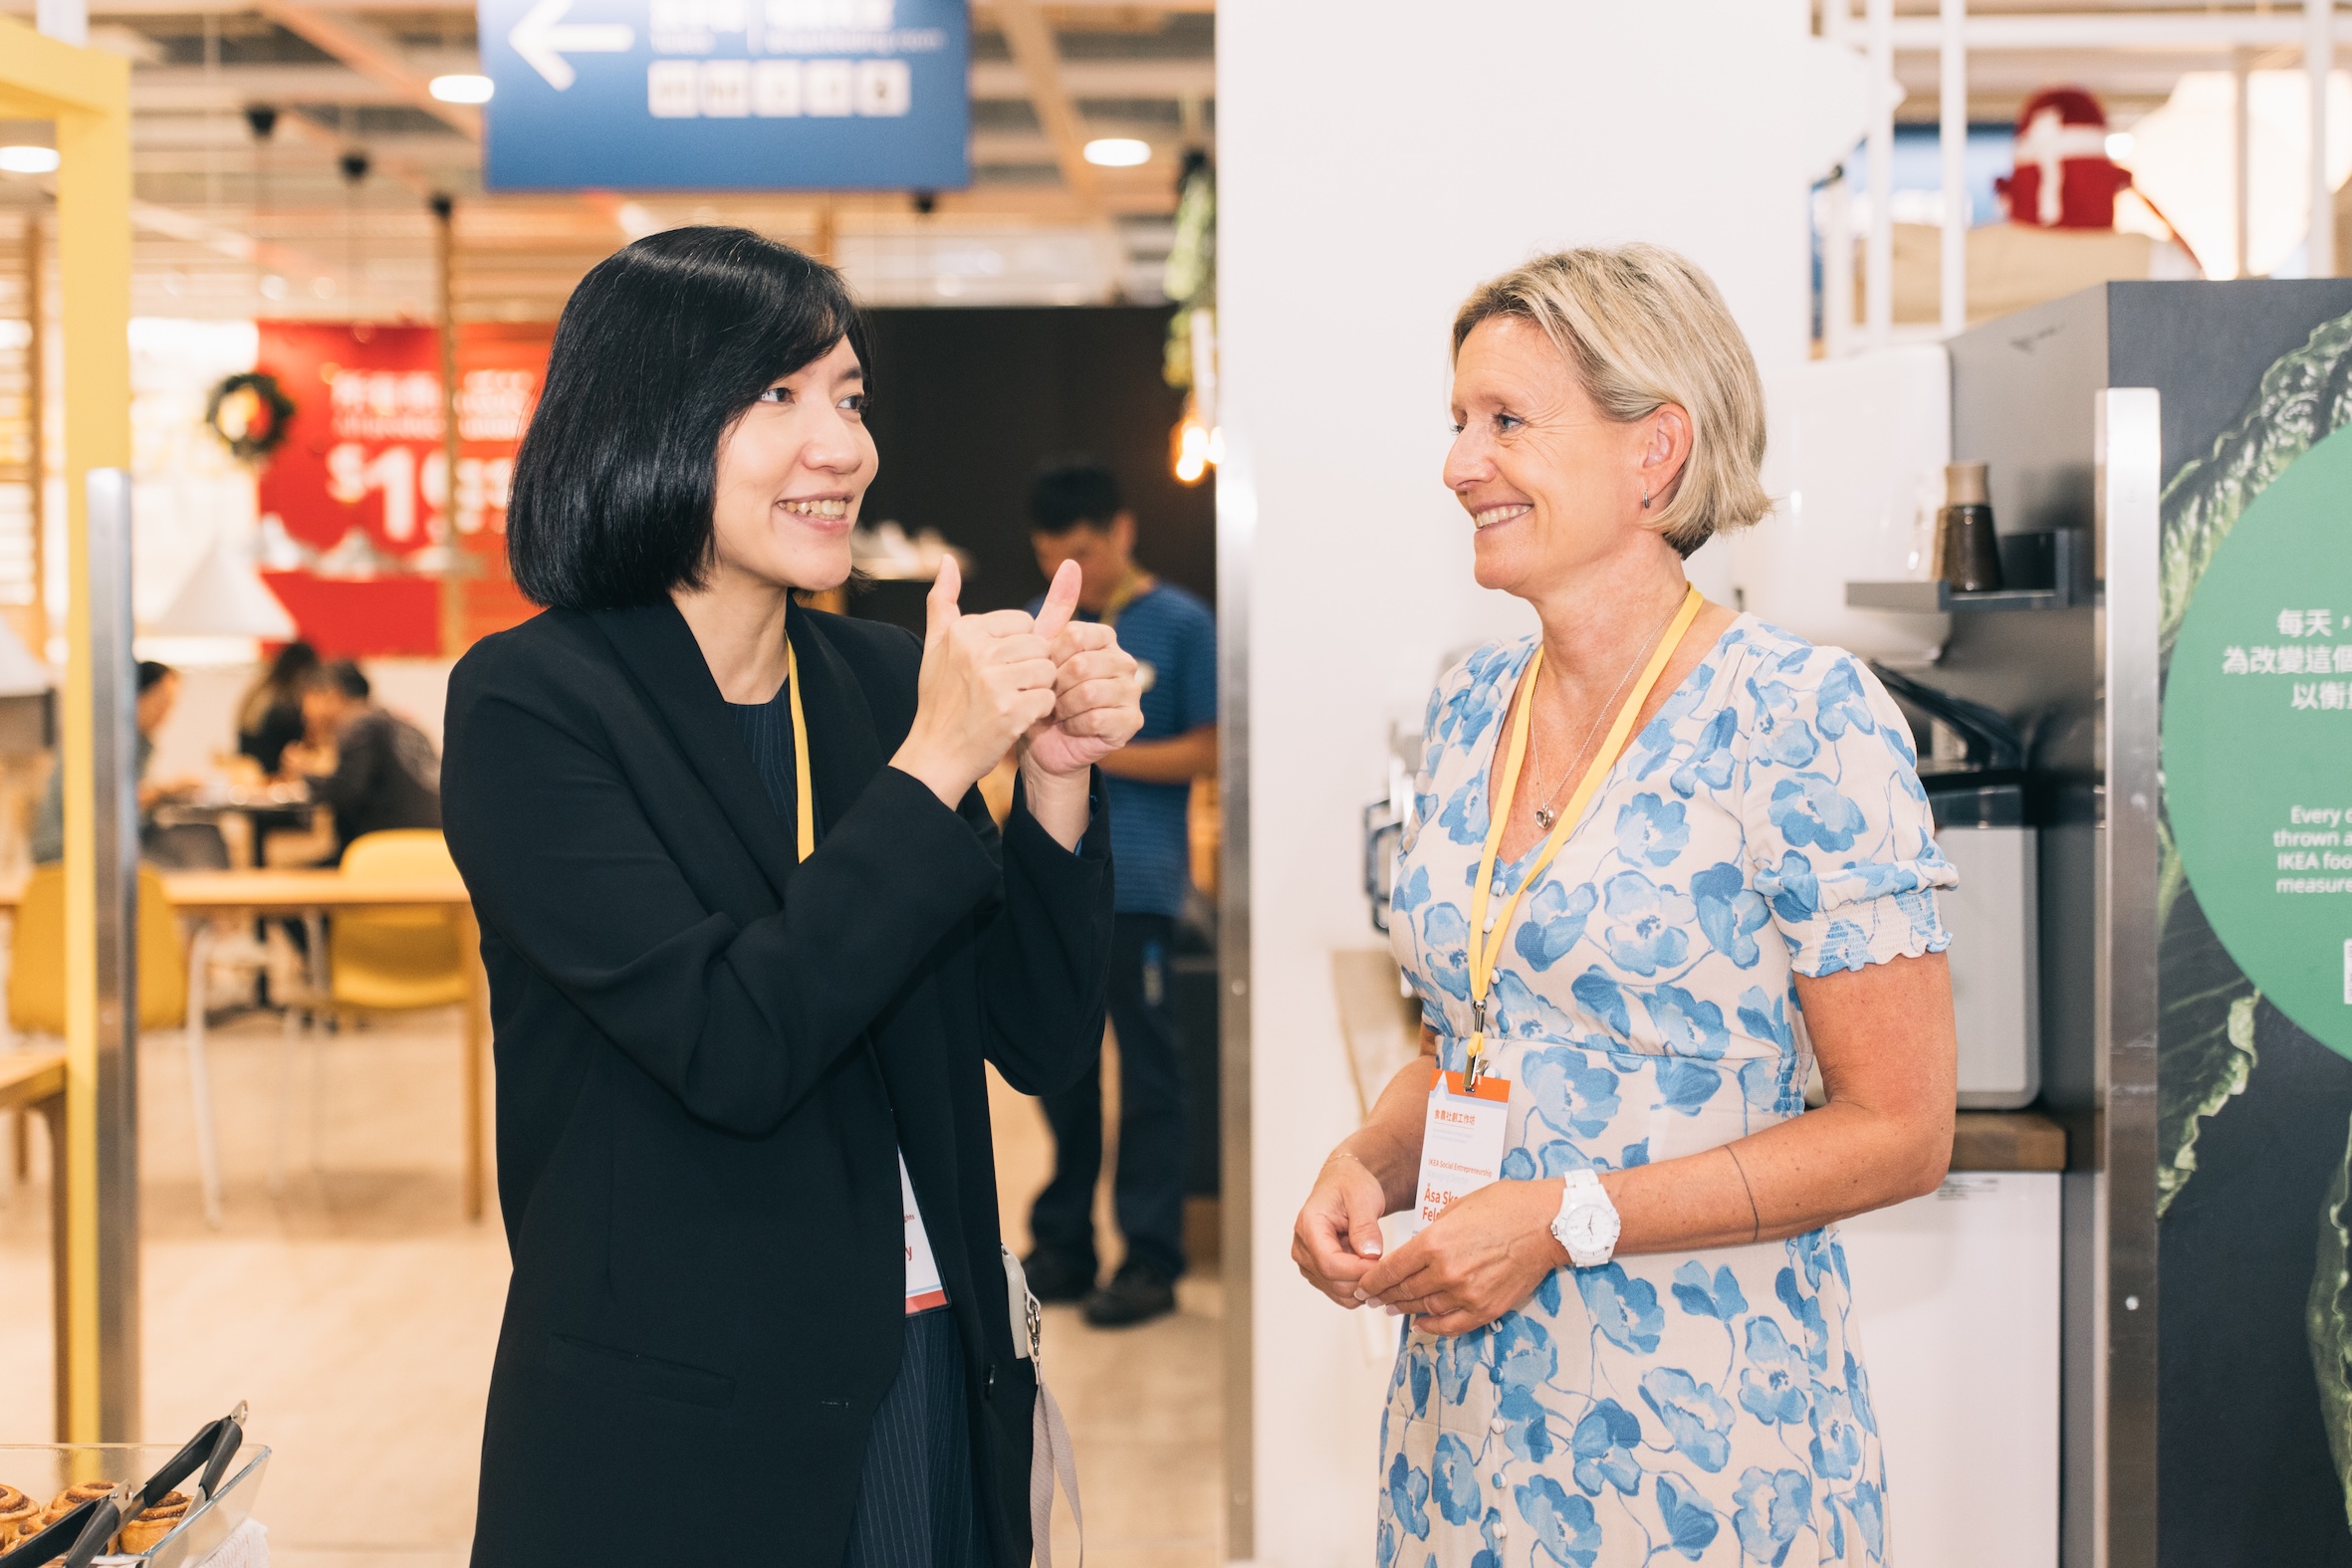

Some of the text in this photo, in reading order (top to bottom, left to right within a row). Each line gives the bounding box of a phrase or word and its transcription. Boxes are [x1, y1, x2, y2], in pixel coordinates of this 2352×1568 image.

[2276, 608, 2352, 638] 每天，
[2290, 681, 2352, 711] 以衡
[2290, 805, 2341, 828] Every
[2273, 829, 2339, 847] thrown
[2277, 852, 2319, 870] IKEA
[1440, 1160, 1454, 1170] Social
[1454, 1163, 1493, 1179] Entrepreneurship
[1424, 1183, 1441, 1204] Åsa
